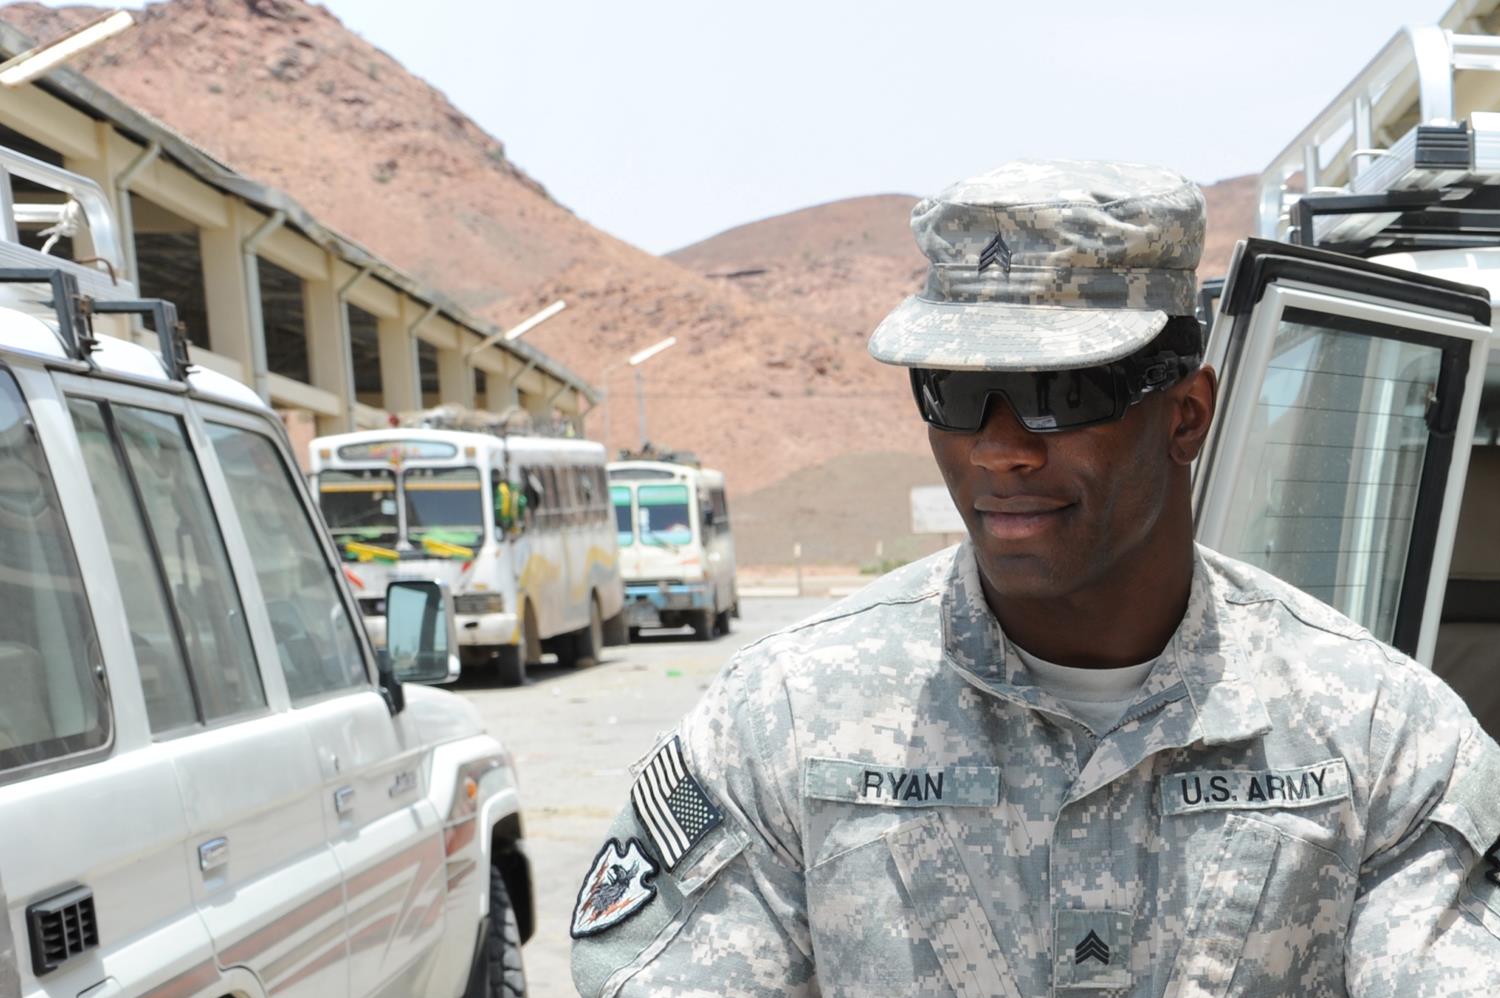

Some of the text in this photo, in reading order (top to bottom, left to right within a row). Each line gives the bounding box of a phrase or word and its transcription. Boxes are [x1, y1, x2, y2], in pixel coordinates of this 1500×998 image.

[863, 771, 944, 801] RYAN
[1182, 769, 1328, 806] U.S. ARMY
